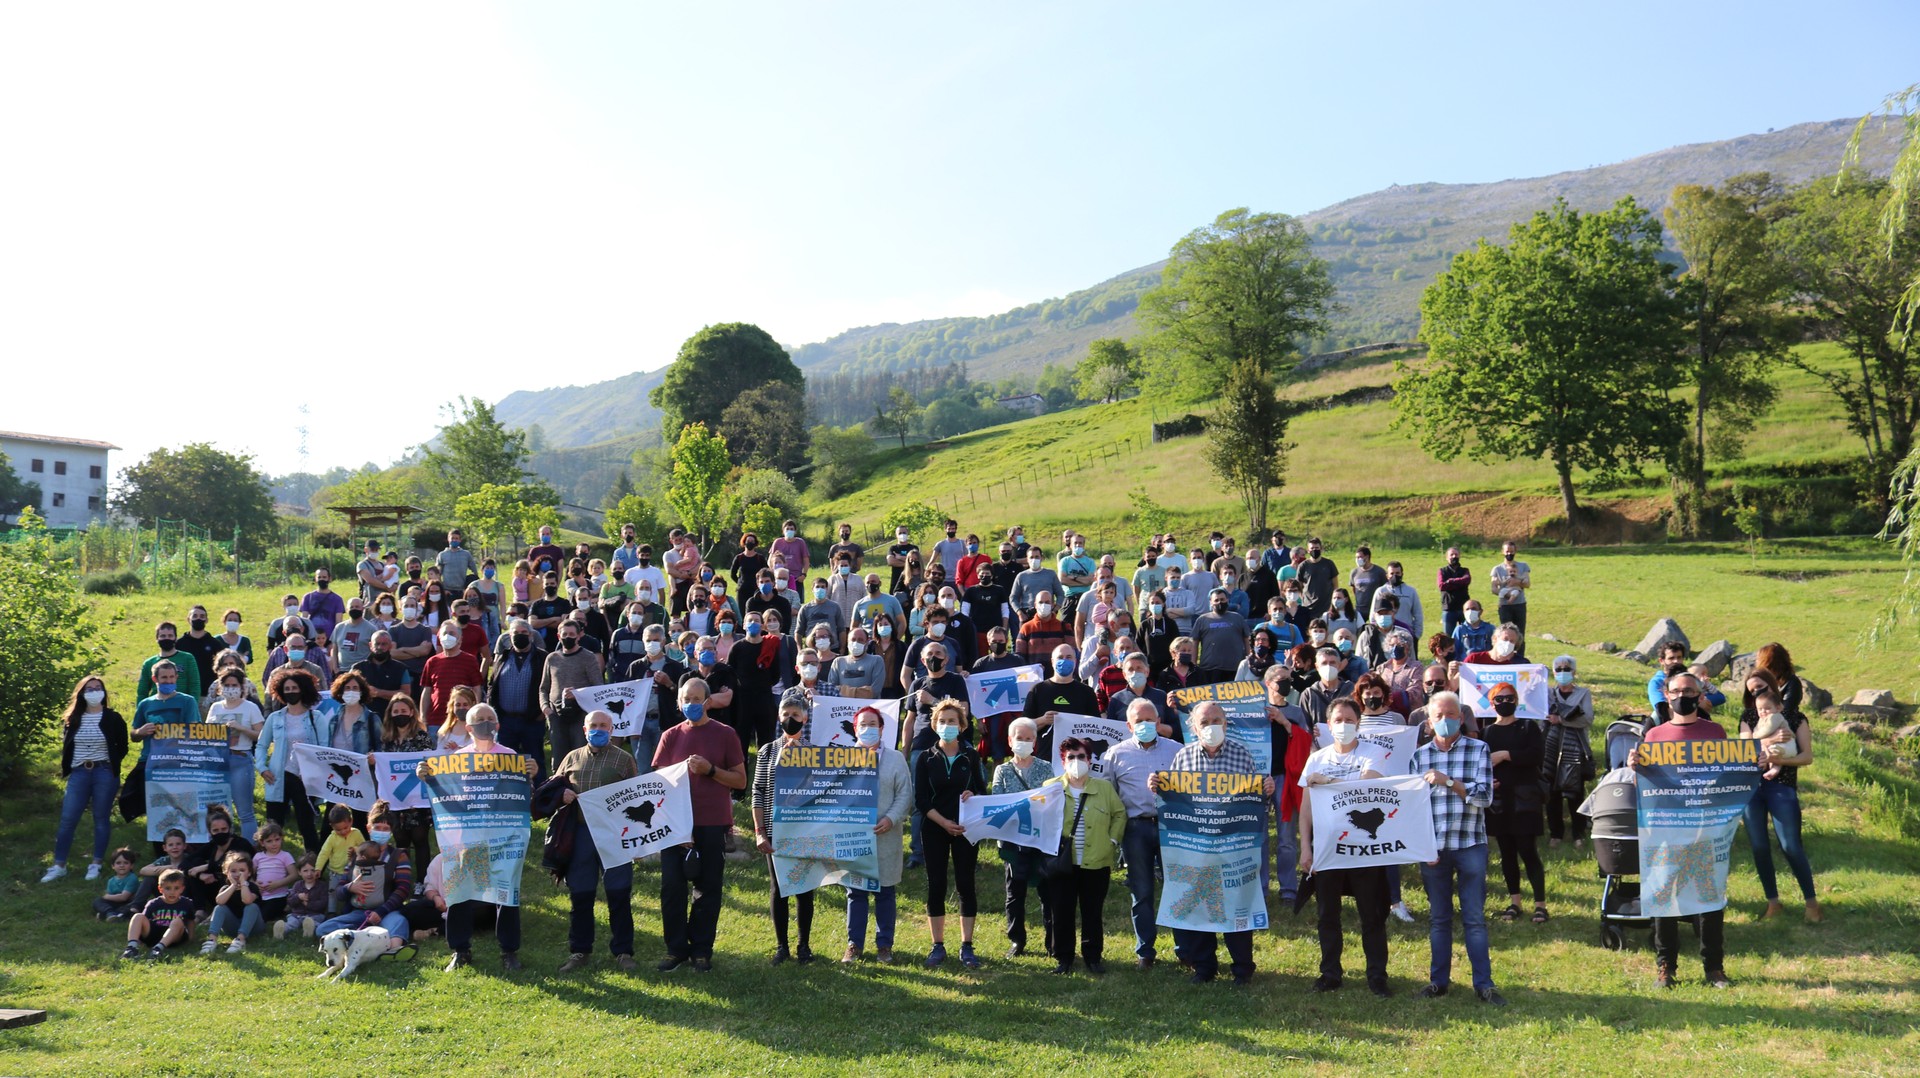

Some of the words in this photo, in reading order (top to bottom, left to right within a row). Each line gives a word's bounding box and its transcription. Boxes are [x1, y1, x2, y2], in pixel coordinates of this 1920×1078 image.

[594, 687, 615, 697] EUSKAL
[1176, 686, 1214, 706] SARE
[1216, 681, 1265, 700] EGUNA
[154, 723, 185, 739] SARE
[189, 724, 227, 740] EGUNA
[1102, 726, 1123, 736] PRESO
[1370, 734, 1393, 743] PRESO
[780, 747, 820, 768] SARE
[825, 748, 876, 768] EGUNA
[1638, 742, 1686, 766] SARE
[1691, 740, 1758, 764] EGUNA
[393, 763, 418, 771] etxe
[427, 754, 469, 776] SARE
[474, 754, 527, 774] EGUNA
[1159, 771, 1202, 794] SARE
[1207, 773, 1263, 795] EGUNA
[326, 781, 363, 799] ETXERA
[605, 787, 634, 804] EUSKAL
[637, 782, 663, 790] PRESO
[1333, 789, 1365, 801] EUSKAL
[1368, 788, 1398, 797] PRESO
[1642, 788, 1696, 796] ELKARTASUN
[1697, 785, 1751, 795] ADIERAZPENA
[432, 794, 476, 803] ELKARTASUN
[607, 801, 621, 813] ETA
[622, 789, 666, 803] IHESLARIAK
[1331, 802, 1347, 811] ETA
[1349, 796, 1400, 806] IHESLARIAK
[1685, 799, 1712, 807] plazan.
[1164, 813, 1207, 824] ELKARTASUN
[1208, 815, 1258, 825] ADIERAZPENA
[621, 825, 672, 849] ETXERA
[1198, 827, 1222, 836] plazan.
[837, 849, 851, 858] IZAN
[853, 847, 872, 856] BIDEA
[1336, 840, 1406, 856] ETXERA
[490, 851, 504, 861] IZAN
[1224, 878, 1240, 888] IZAN
